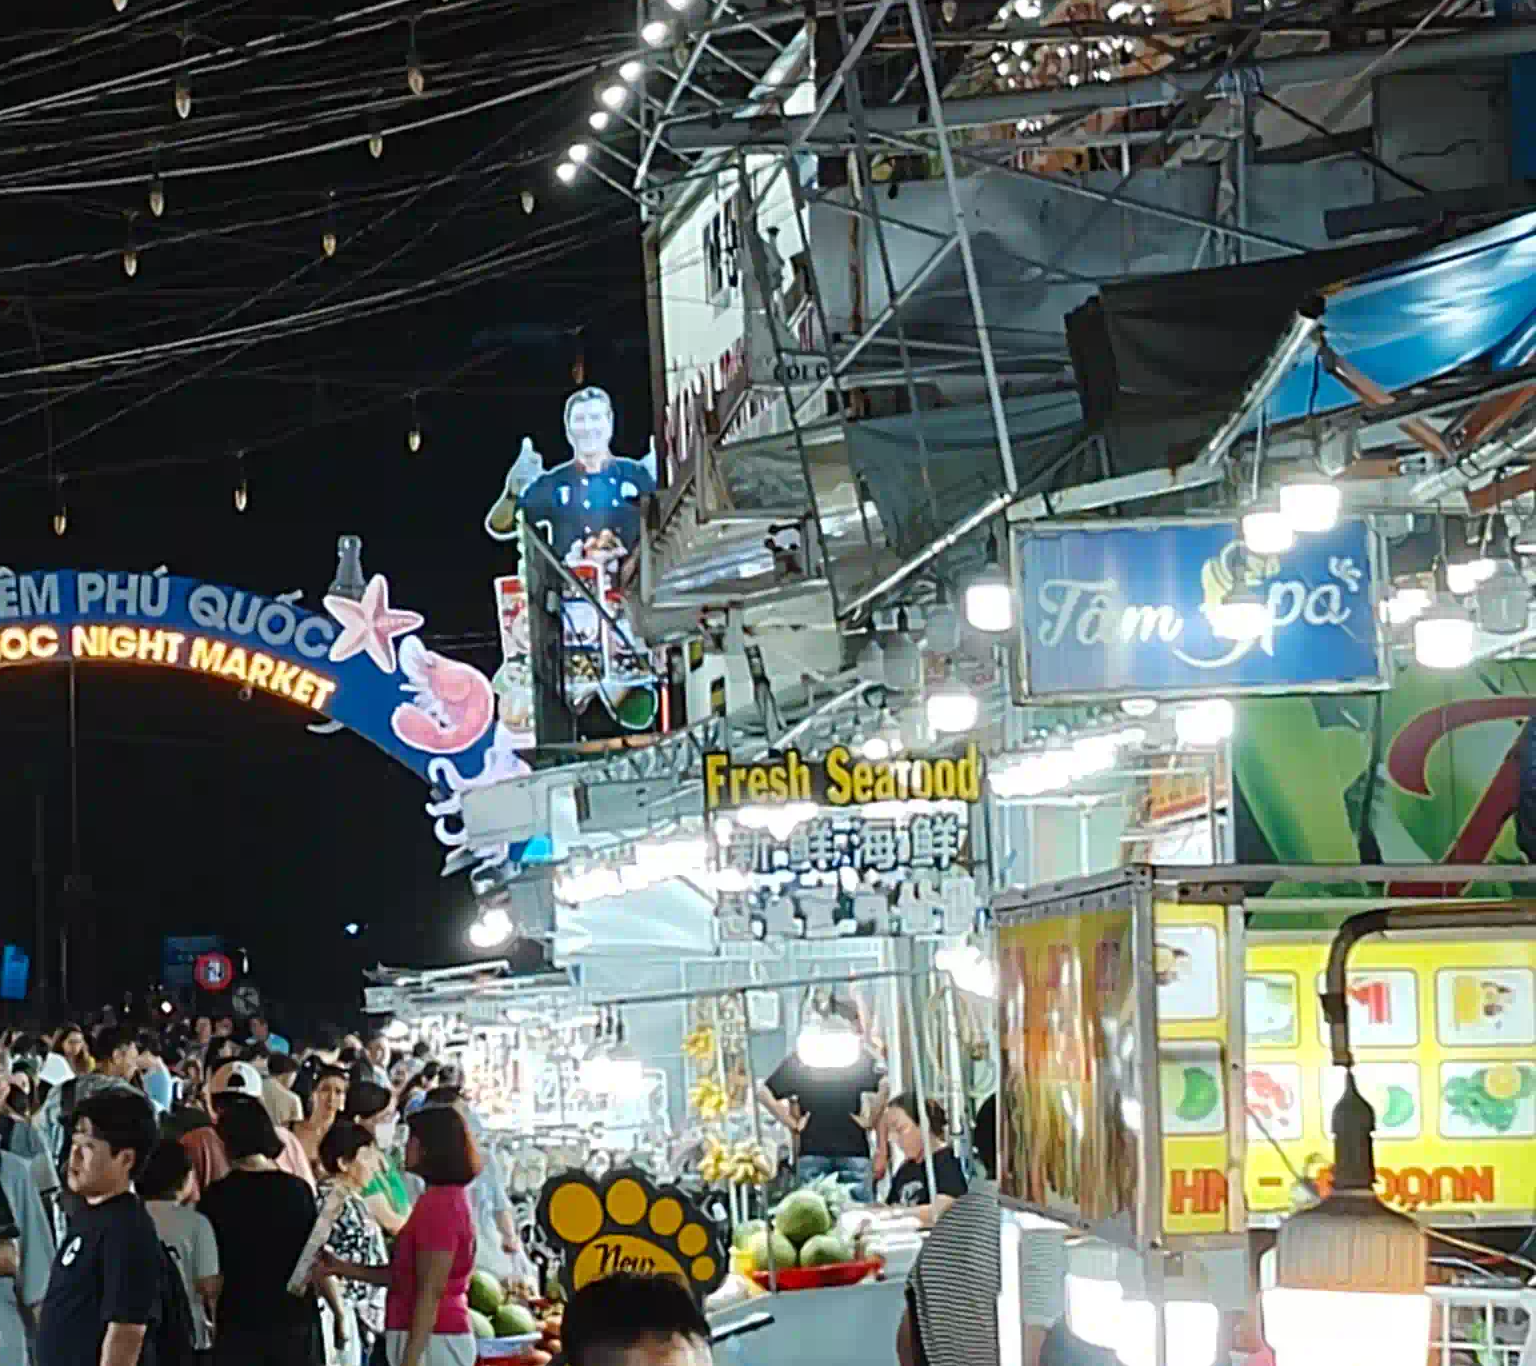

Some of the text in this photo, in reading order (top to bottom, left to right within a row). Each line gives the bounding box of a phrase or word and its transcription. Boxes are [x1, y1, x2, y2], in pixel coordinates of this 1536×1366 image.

[77, 565, 170, 617] PHÚ
[188, 589, 335, 658] QUỐC
[71, 624, 185, 664] NIGHT
[189, 636, 337, 710] MARKET
[705, 742, 982, 807] Fresh Seafood
